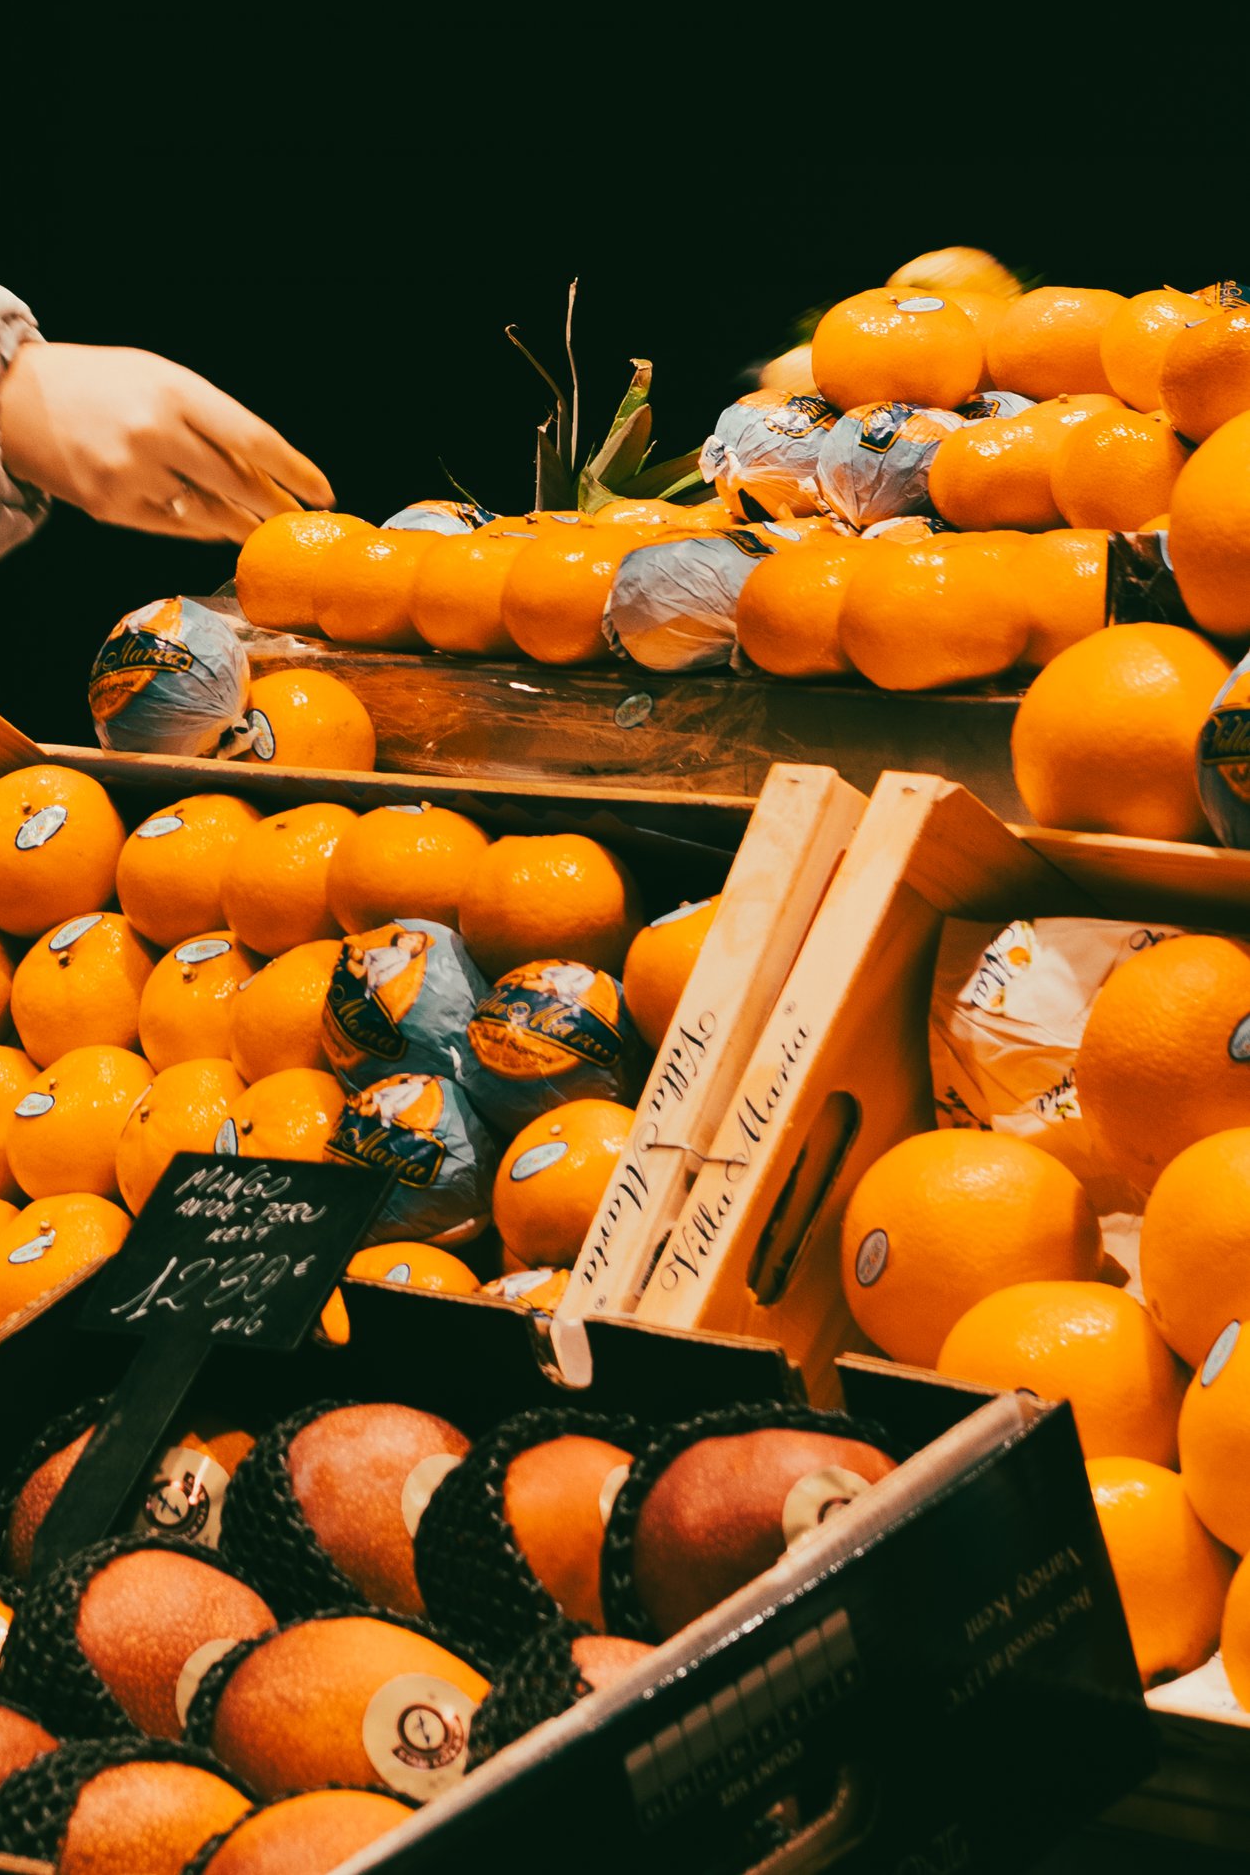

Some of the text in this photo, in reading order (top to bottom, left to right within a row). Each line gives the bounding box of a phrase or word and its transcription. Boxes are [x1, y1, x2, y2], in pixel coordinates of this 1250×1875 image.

[648, 1010, 717, 1114] Villa
[173, 1163, 292, 1200] MANGO
[659, 1190, 734, 1291] Villa
[963, 1545, 1084, 1645] Variety Kent
[1056, 1584, 1094, 1625] Best
[1004, 1613, 1058, 1668] Stored
